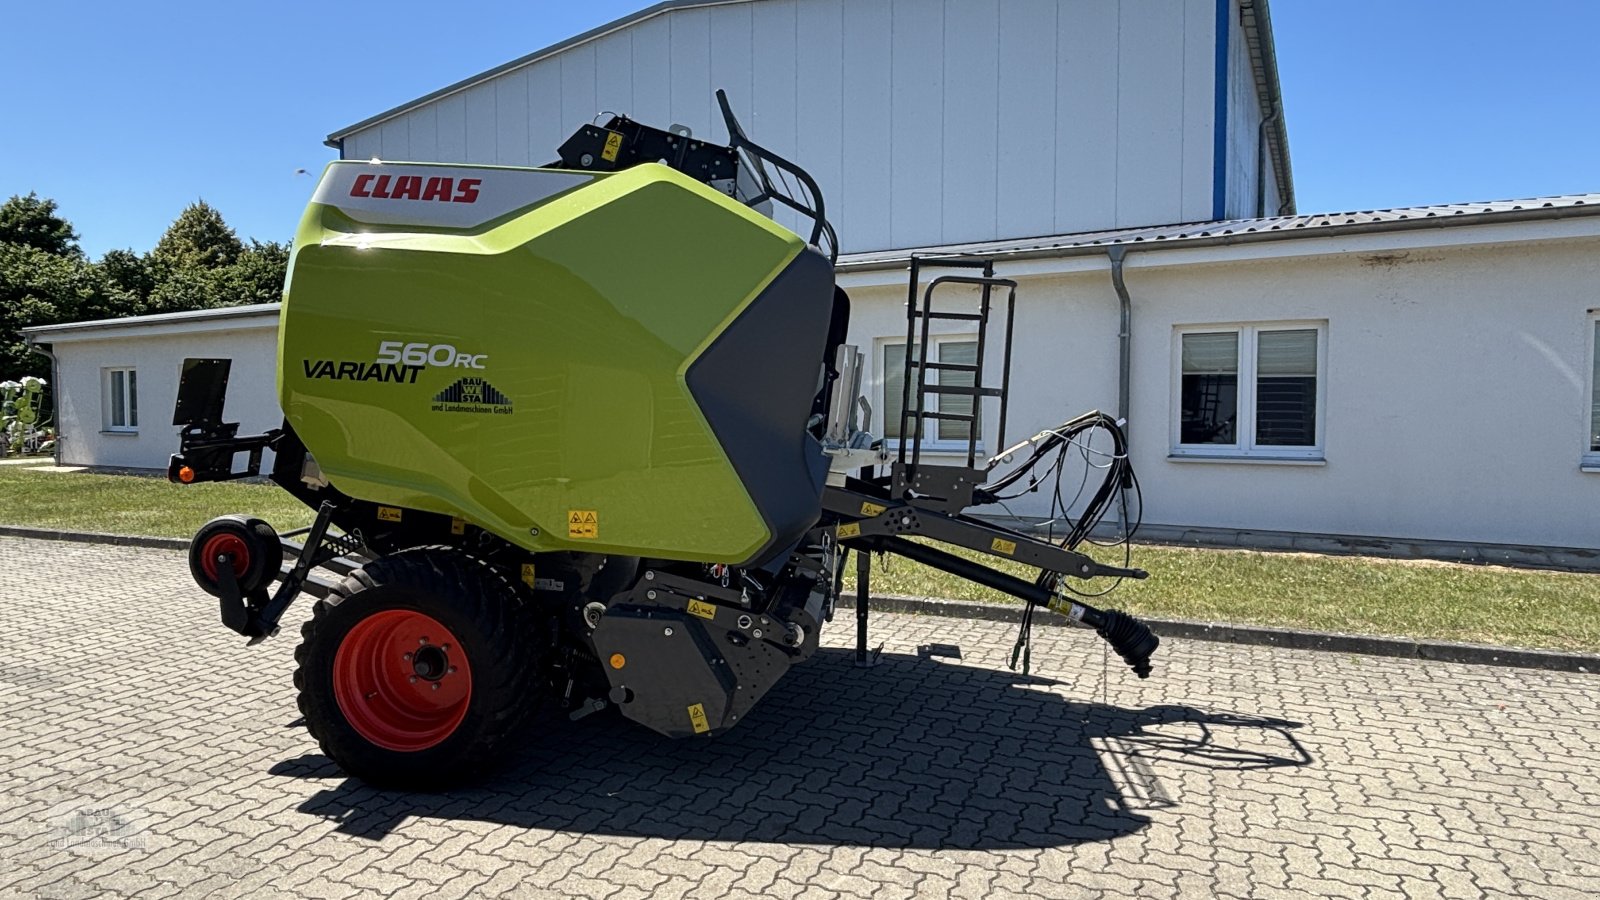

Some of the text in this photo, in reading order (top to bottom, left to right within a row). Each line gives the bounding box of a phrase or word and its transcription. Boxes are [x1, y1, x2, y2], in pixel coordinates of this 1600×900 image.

[350, 174, 482, 204] CLAAS
[303, 359, 425, 384] VARIANT
[462, 377, 482, 386] BAU
[462, 394, 482, 403] STA
[431, 404, 513, 415] und Landmaschinen GmbH
